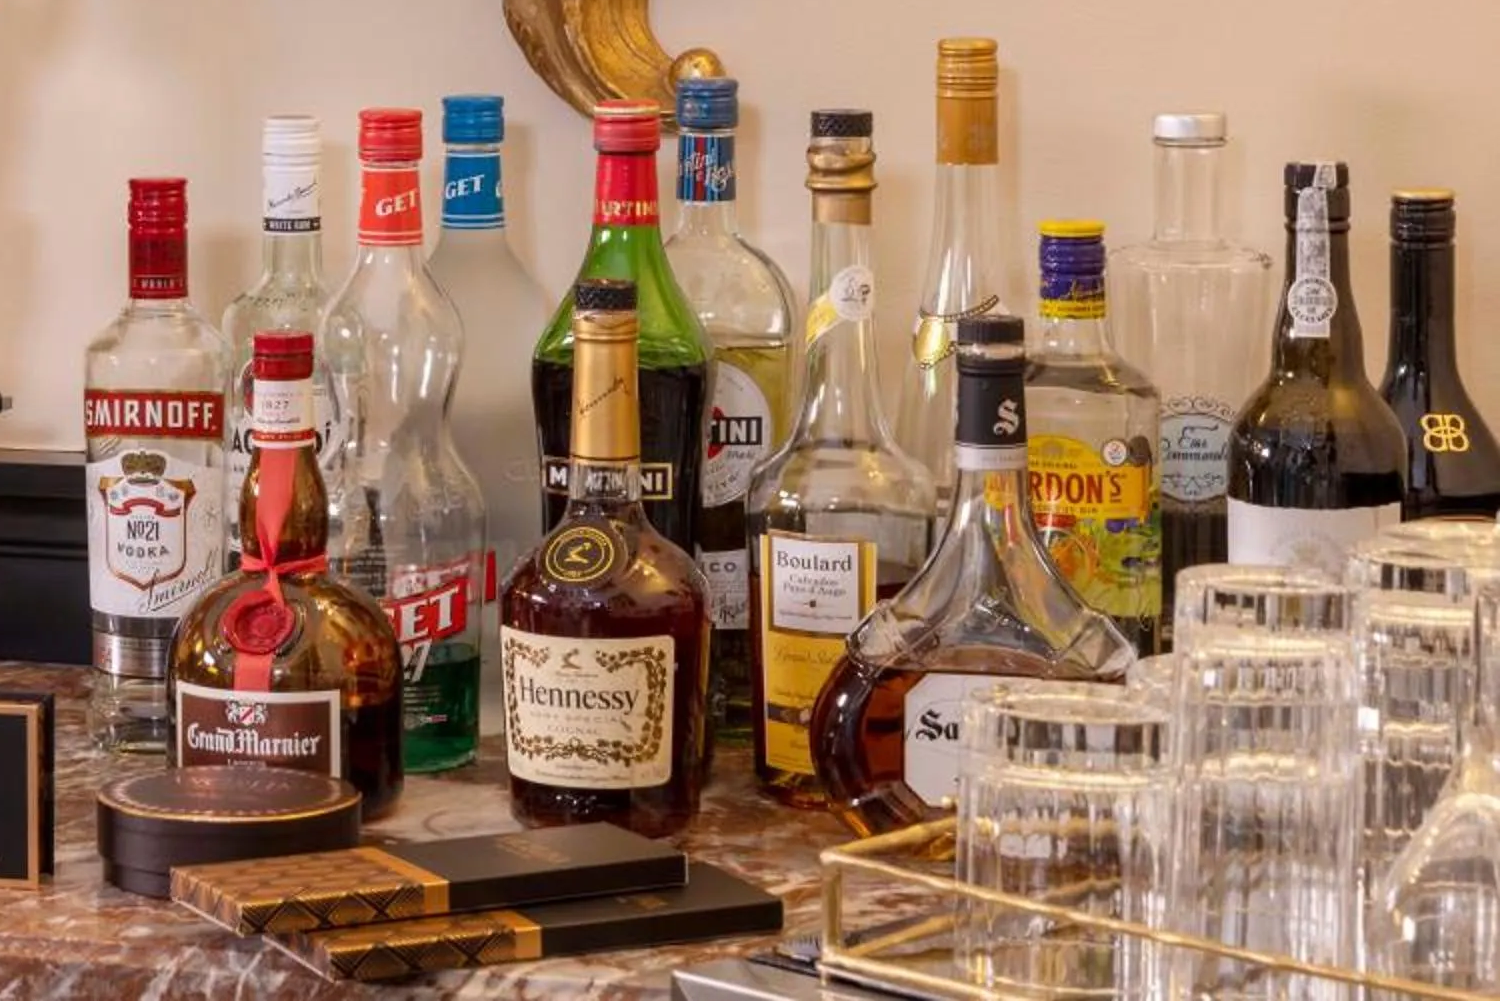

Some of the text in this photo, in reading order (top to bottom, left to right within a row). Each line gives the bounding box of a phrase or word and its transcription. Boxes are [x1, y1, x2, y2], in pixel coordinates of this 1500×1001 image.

[445, 173, 485, 199] GET
[374, 189, 418, 217] GET
[708, 420, 757, 443] TINI
[1028, 470, 1122, 504] RDON'S
[117, 542, 170, 559] VODKA
[776, 549, 853, 572] Boulard
[789, 573, 840, 587] Calvados
[519, 675, 639, 715] Hennessy
[187, 722, 322, 757] Grand Marnier
